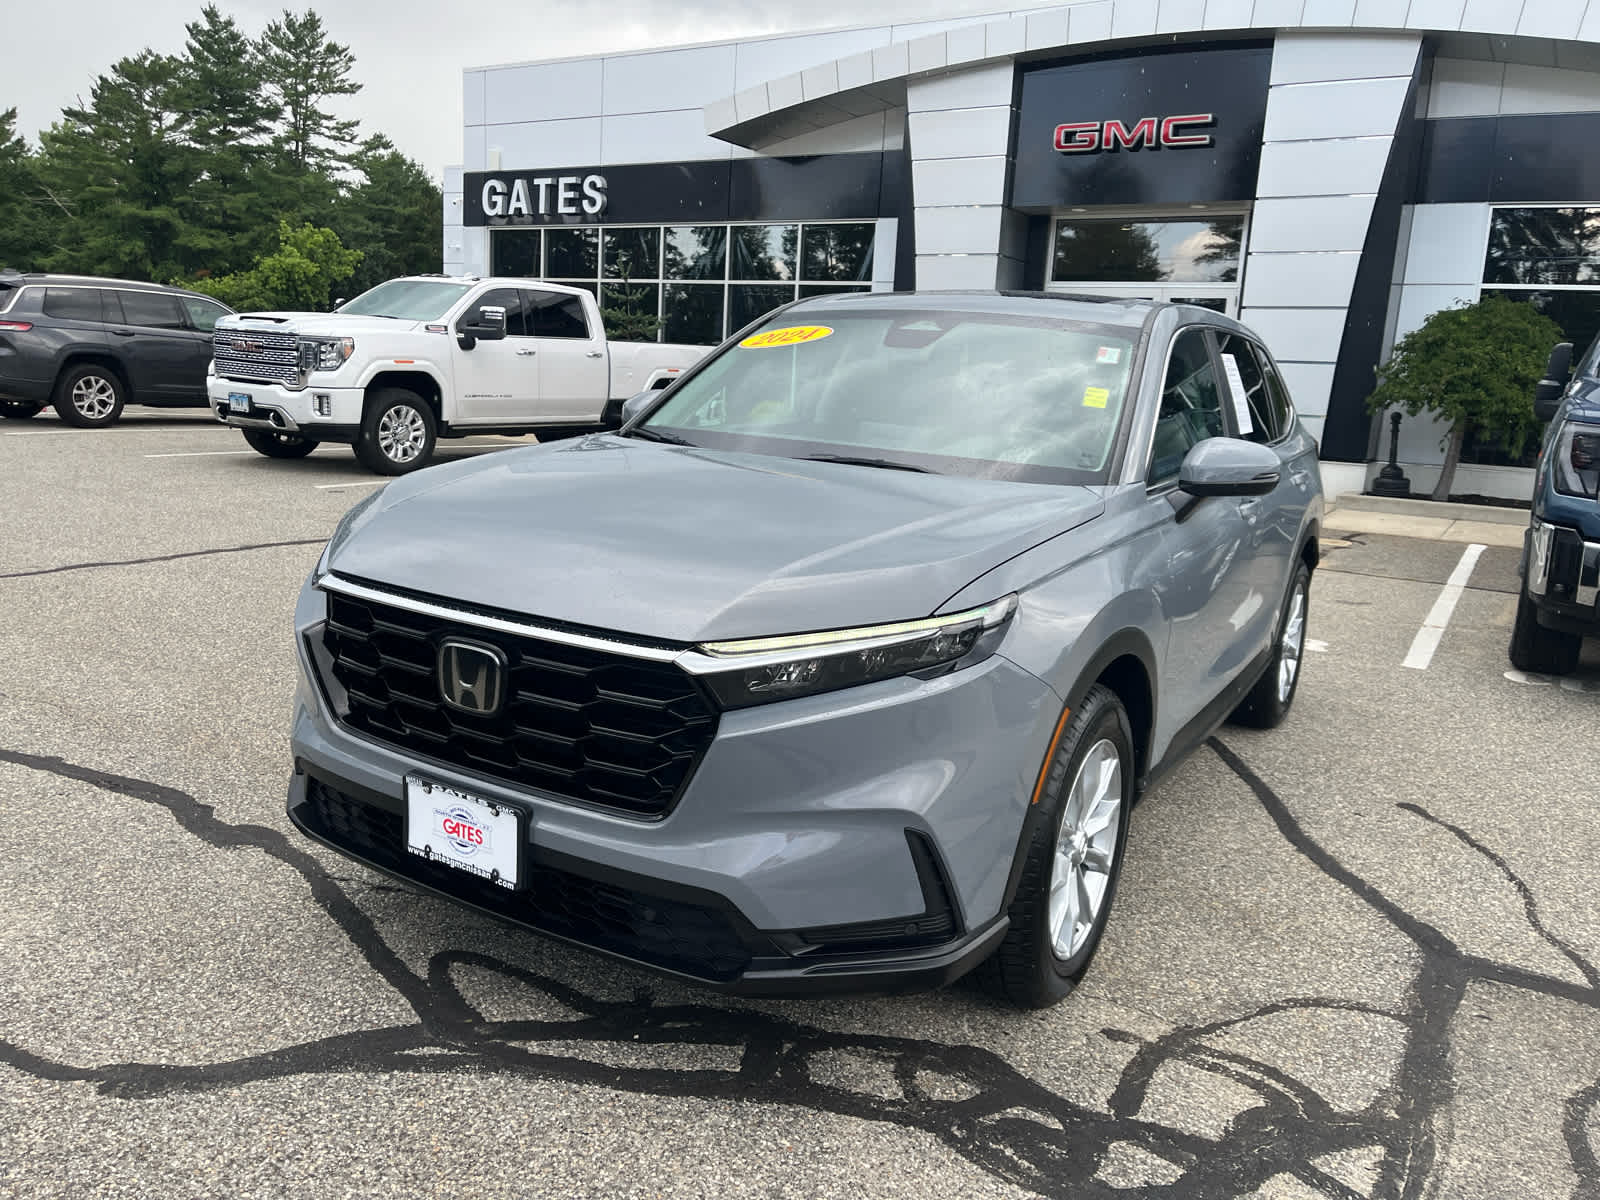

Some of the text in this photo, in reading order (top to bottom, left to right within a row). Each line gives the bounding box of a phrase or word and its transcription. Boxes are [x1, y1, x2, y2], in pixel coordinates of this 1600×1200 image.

[1053, 113, 1213, 152] GMC
[481, 174, 608, 216] GATES
[751, 327, 822, 346] 2024
[442, 818, 484, 846] GATES
